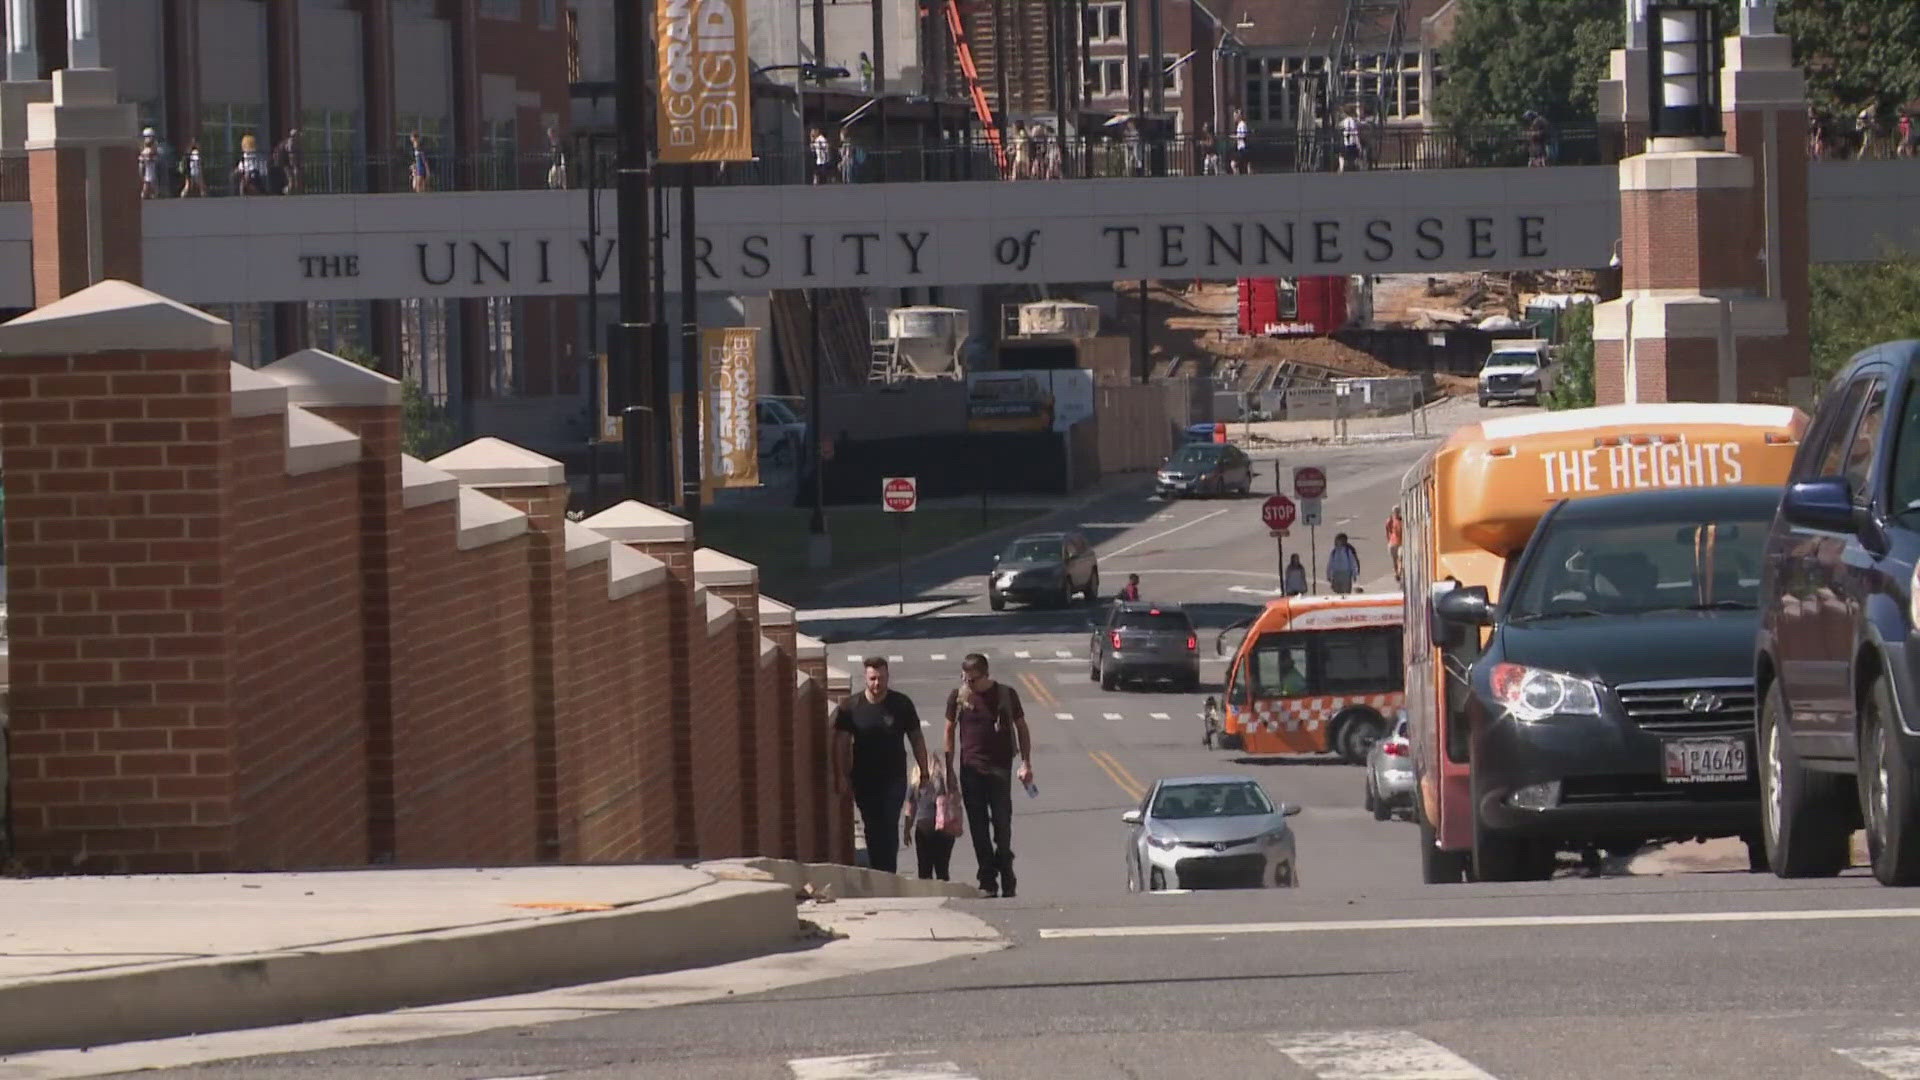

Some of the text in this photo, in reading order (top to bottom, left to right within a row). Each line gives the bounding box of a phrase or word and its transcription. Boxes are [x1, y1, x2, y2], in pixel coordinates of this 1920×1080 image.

[299, 214, 1550, 286] THE UNIVRSITY of TENNESSEE
[1539, 441, 1742, 494] THE HEIGHTS
[1264, 504, 1294, 520] STOP
